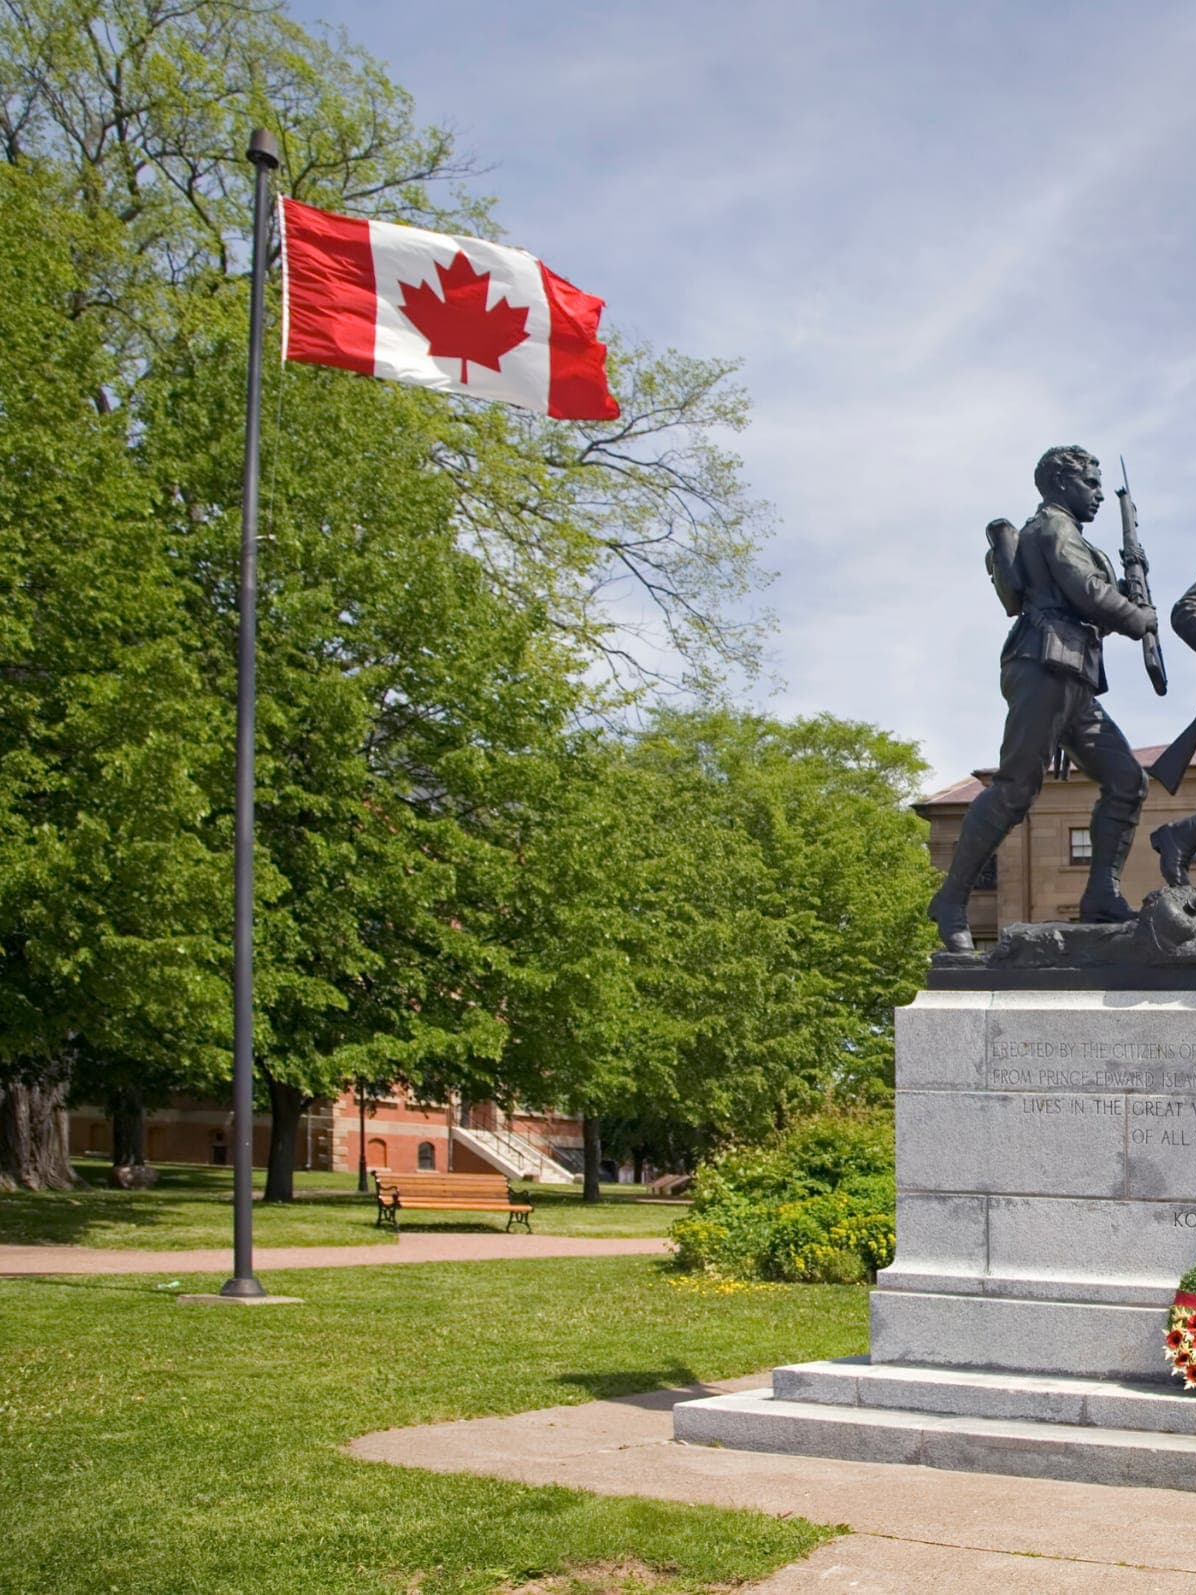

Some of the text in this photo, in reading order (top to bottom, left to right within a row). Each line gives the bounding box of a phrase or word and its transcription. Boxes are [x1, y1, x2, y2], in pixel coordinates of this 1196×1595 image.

[992, 1042, 1054, 1057] ERECTED
[1059, 1042, 1075, 1058] BY
[1081, 1042, 1106, 1058] THE
[1112, 1043, 1175, 1059] CITIZENS
[992, 1069, 1032, 1084] FROM
[1039, 1070, 1088, 1086] PRINCE
[1095, 1071, 1154, 1088] EDWARD
[1023, 1099, 1062, 1115] LIVES
[1070, 1100, 1085, 1115] IN
[1093, 1100, 1122, 1116] THE
[1132, 1101, 1183, 1117] GREAT
[1132, 1129, 1153, 1145] OF
[1161, 1130, 1190, 1146] ALL
